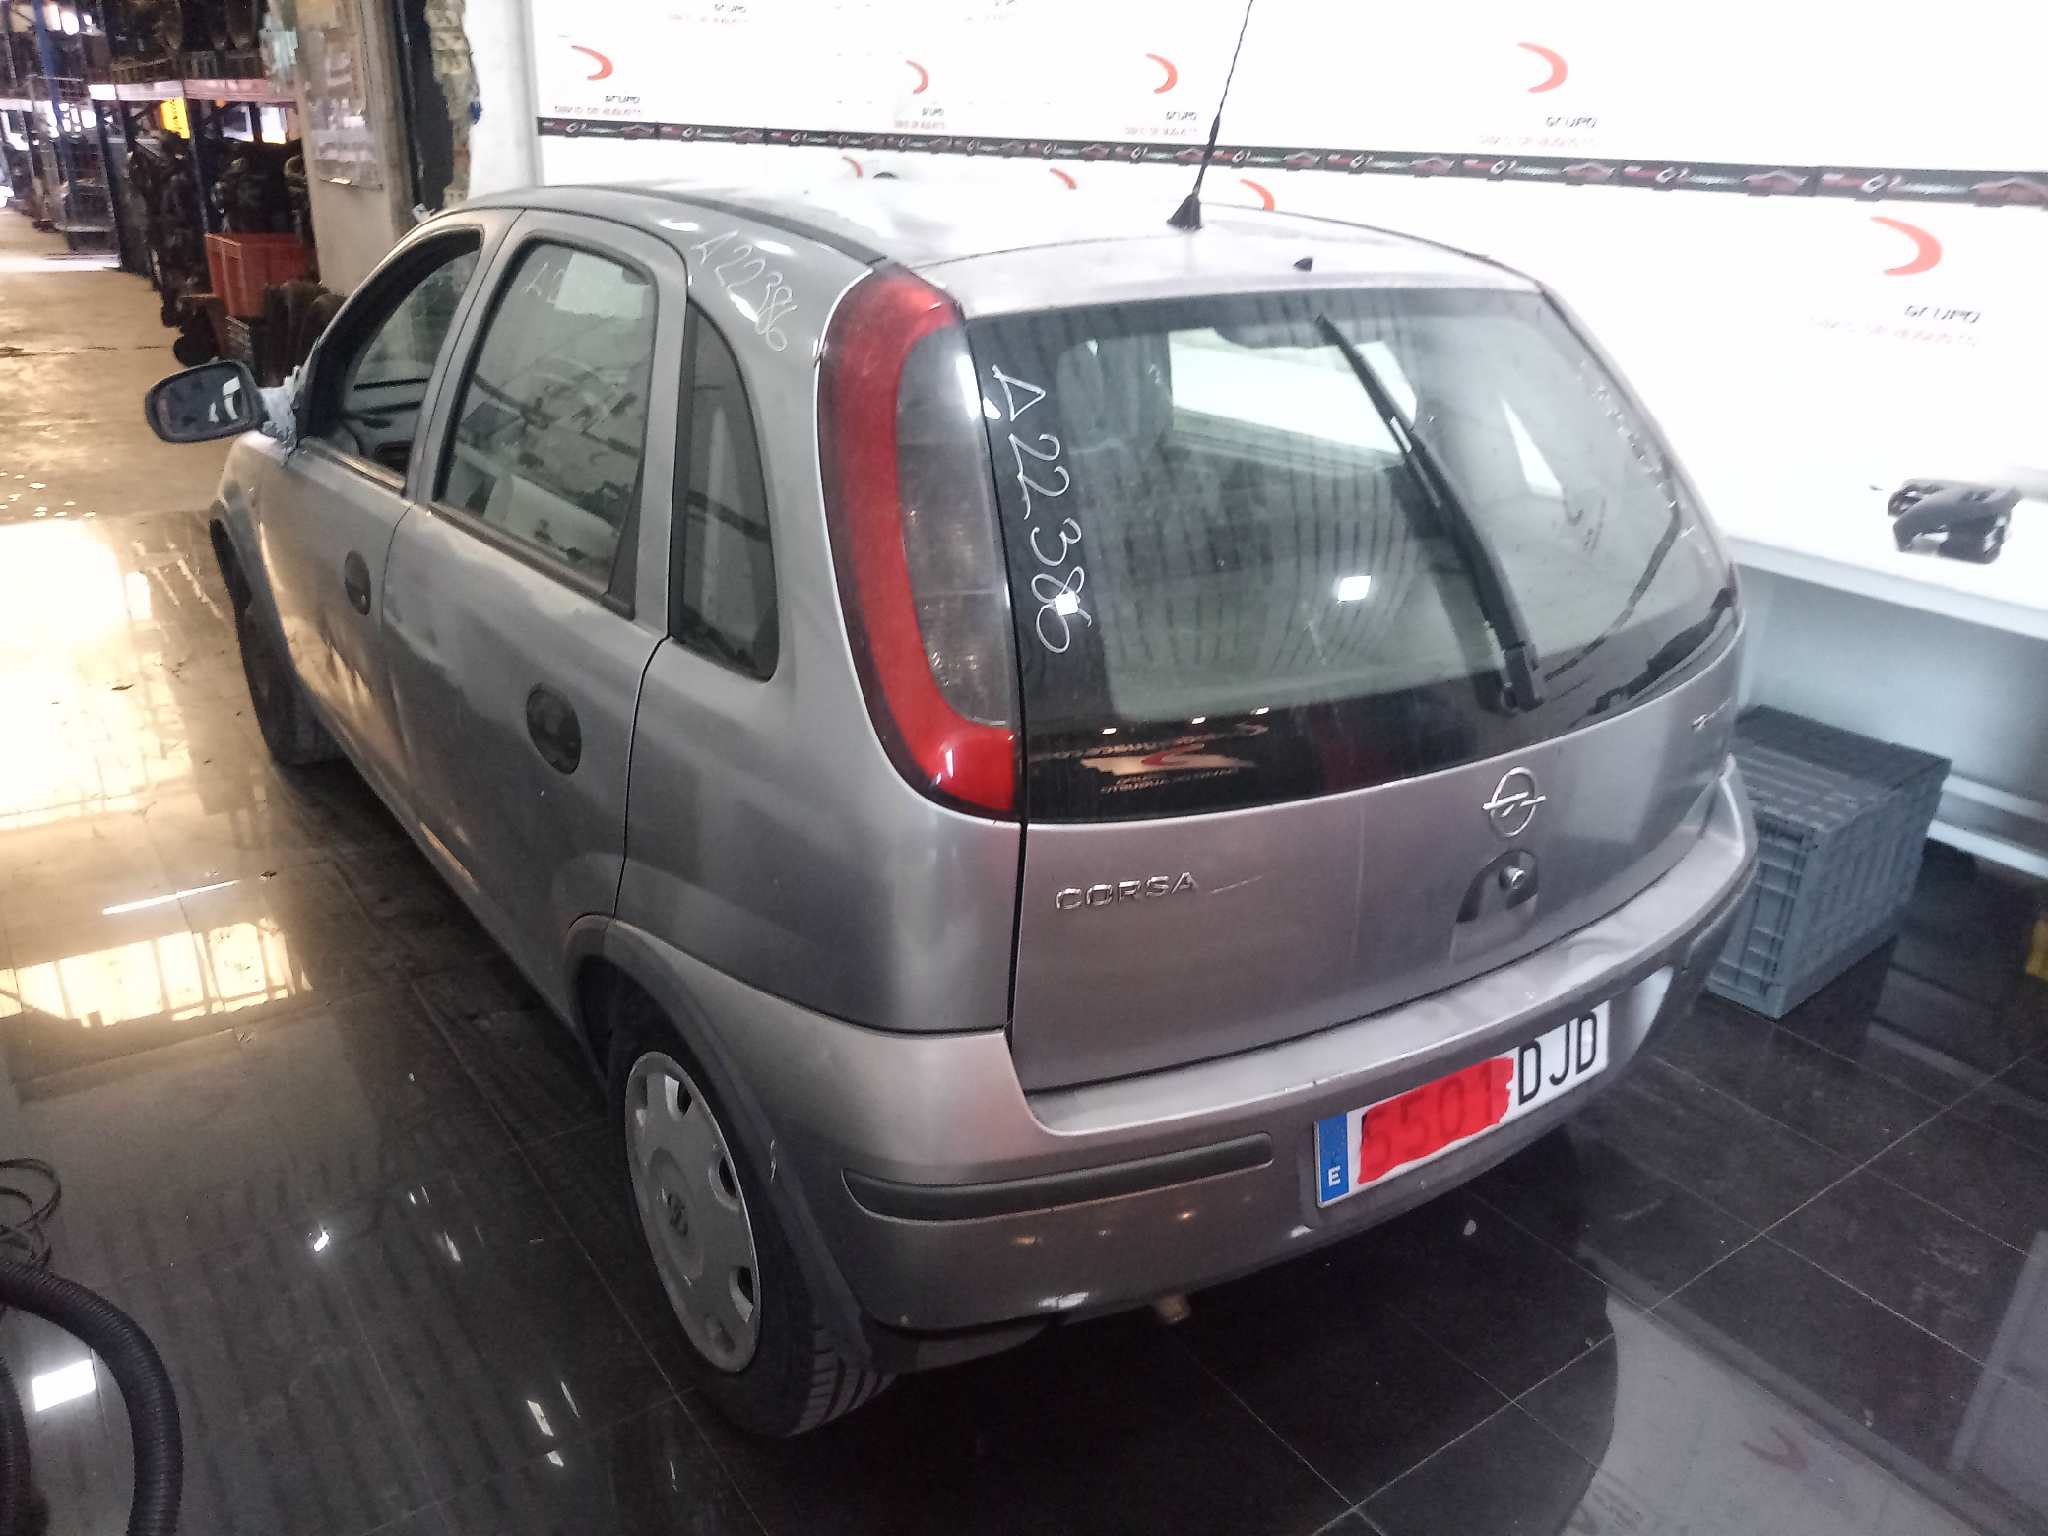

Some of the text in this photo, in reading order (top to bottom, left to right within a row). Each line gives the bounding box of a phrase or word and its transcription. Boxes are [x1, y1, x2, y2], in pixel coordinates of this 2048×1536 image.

[992, 365, 1092, 653] A22386
[1055, 871, 1200, 911] CORSA
[1328, 1010, 1598, 1187] E DJD
